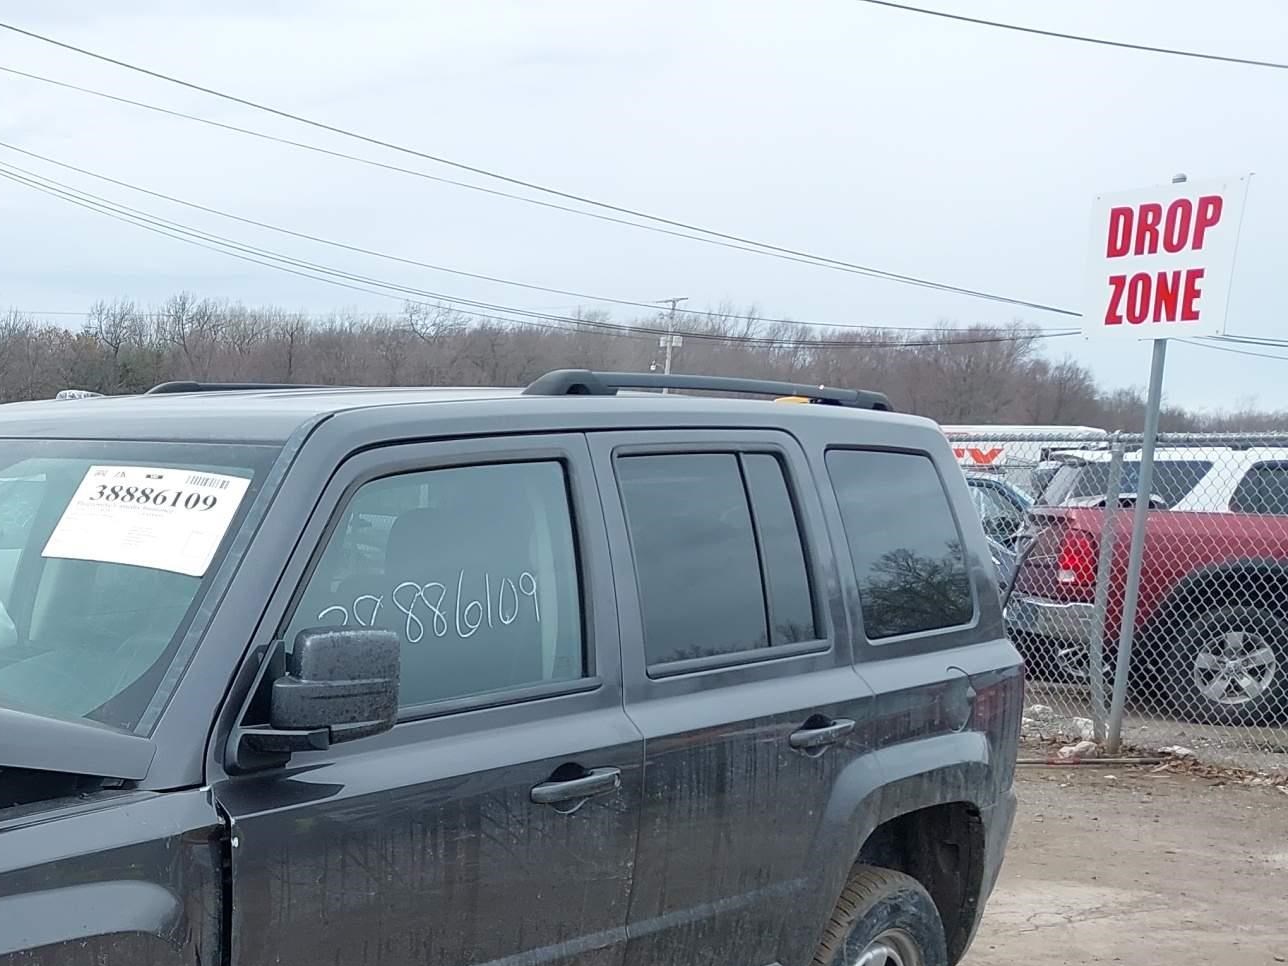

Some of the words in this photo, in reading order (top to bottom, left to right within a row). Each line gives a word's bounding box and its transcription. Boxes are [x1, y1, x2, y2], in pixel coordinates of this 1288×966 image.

[1106, 195, 1224, 259] DROP
[1104, 267, 1205, 326] ZONE
[89, 484, 218, 512] 38886109
